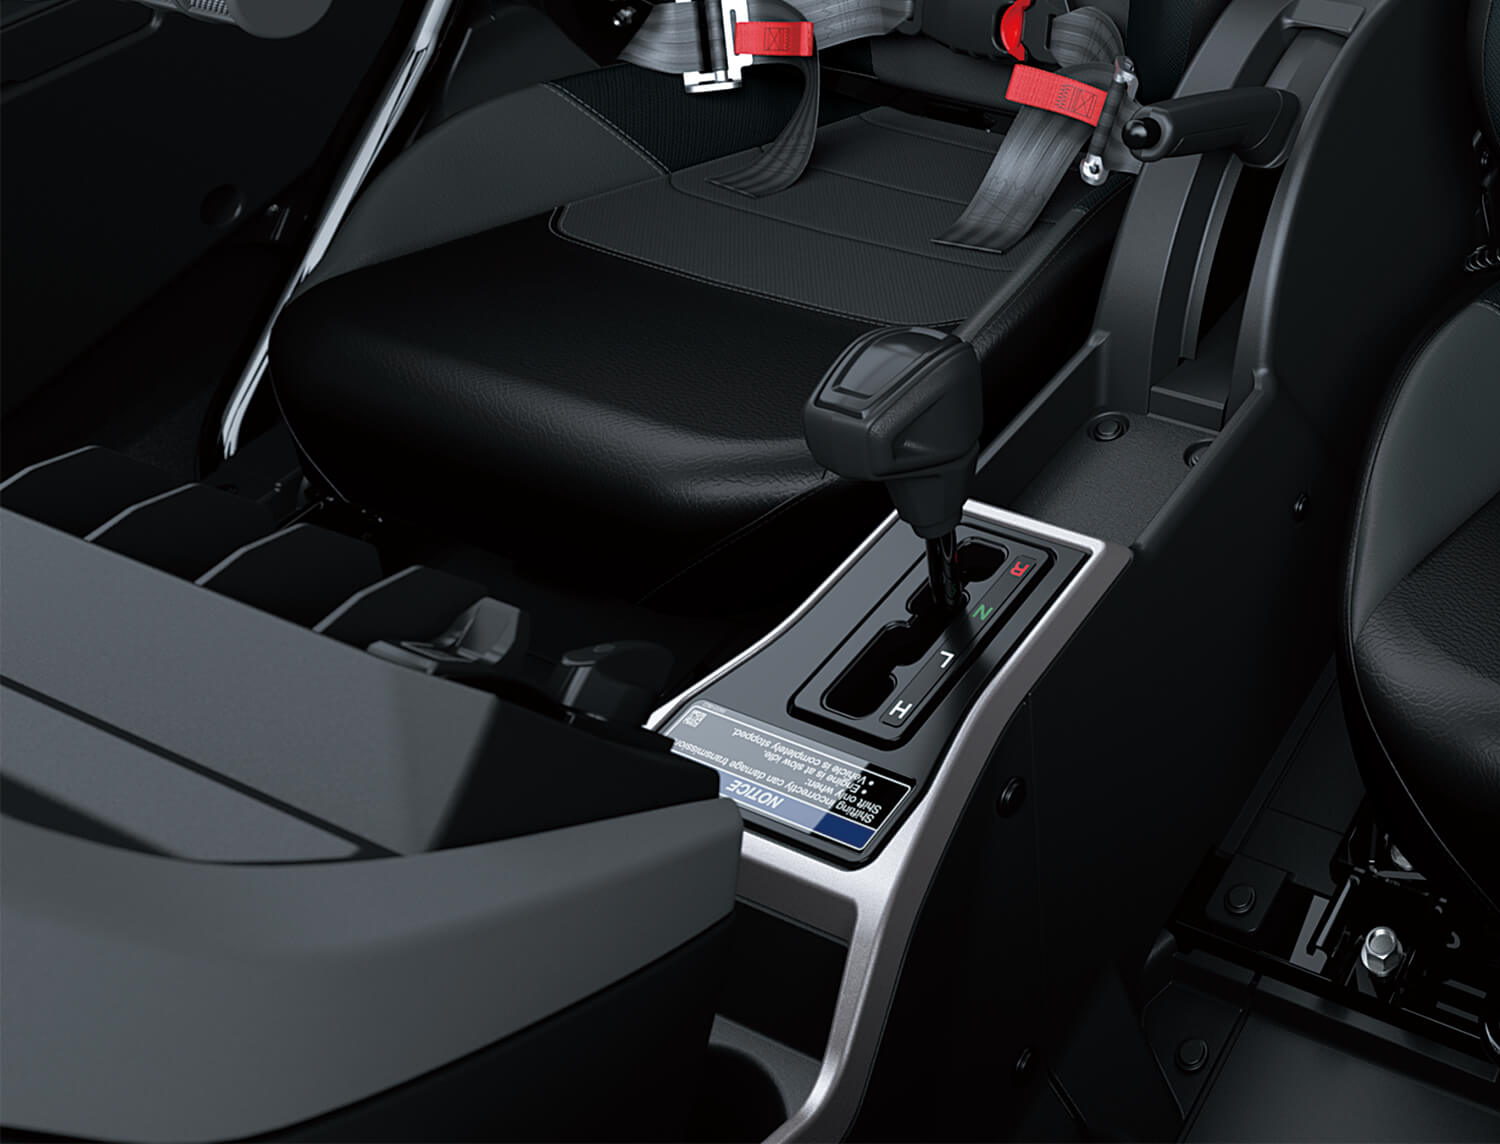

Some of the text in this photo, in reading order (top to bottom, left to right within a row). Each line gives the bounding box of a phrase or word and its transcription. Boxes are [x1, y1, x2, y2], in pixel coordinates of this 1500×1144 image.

[1010, 561, 1030, 577] R
[972, 604, 993, 621] N
[940, 650, 955, 669] L
[889, 700, 913, 719] H
[731, 727, 867, 785] Vehicle is completely stopped.
[782, 758, 805, 772] slow
[729, 760, 766, 780] damage
[803, 766, 816, 775] at
[815, 770, 826, 780] is
[765, 775, 785, 786] can
[826, 775, 861, 794] Engine
[725, 779, 785, 808] NOTICE
[784, 781, 836, 809] incorrectly
[804, 779, 882, 815] Shift only when:
[835, 800, 875, 824] Shifting
